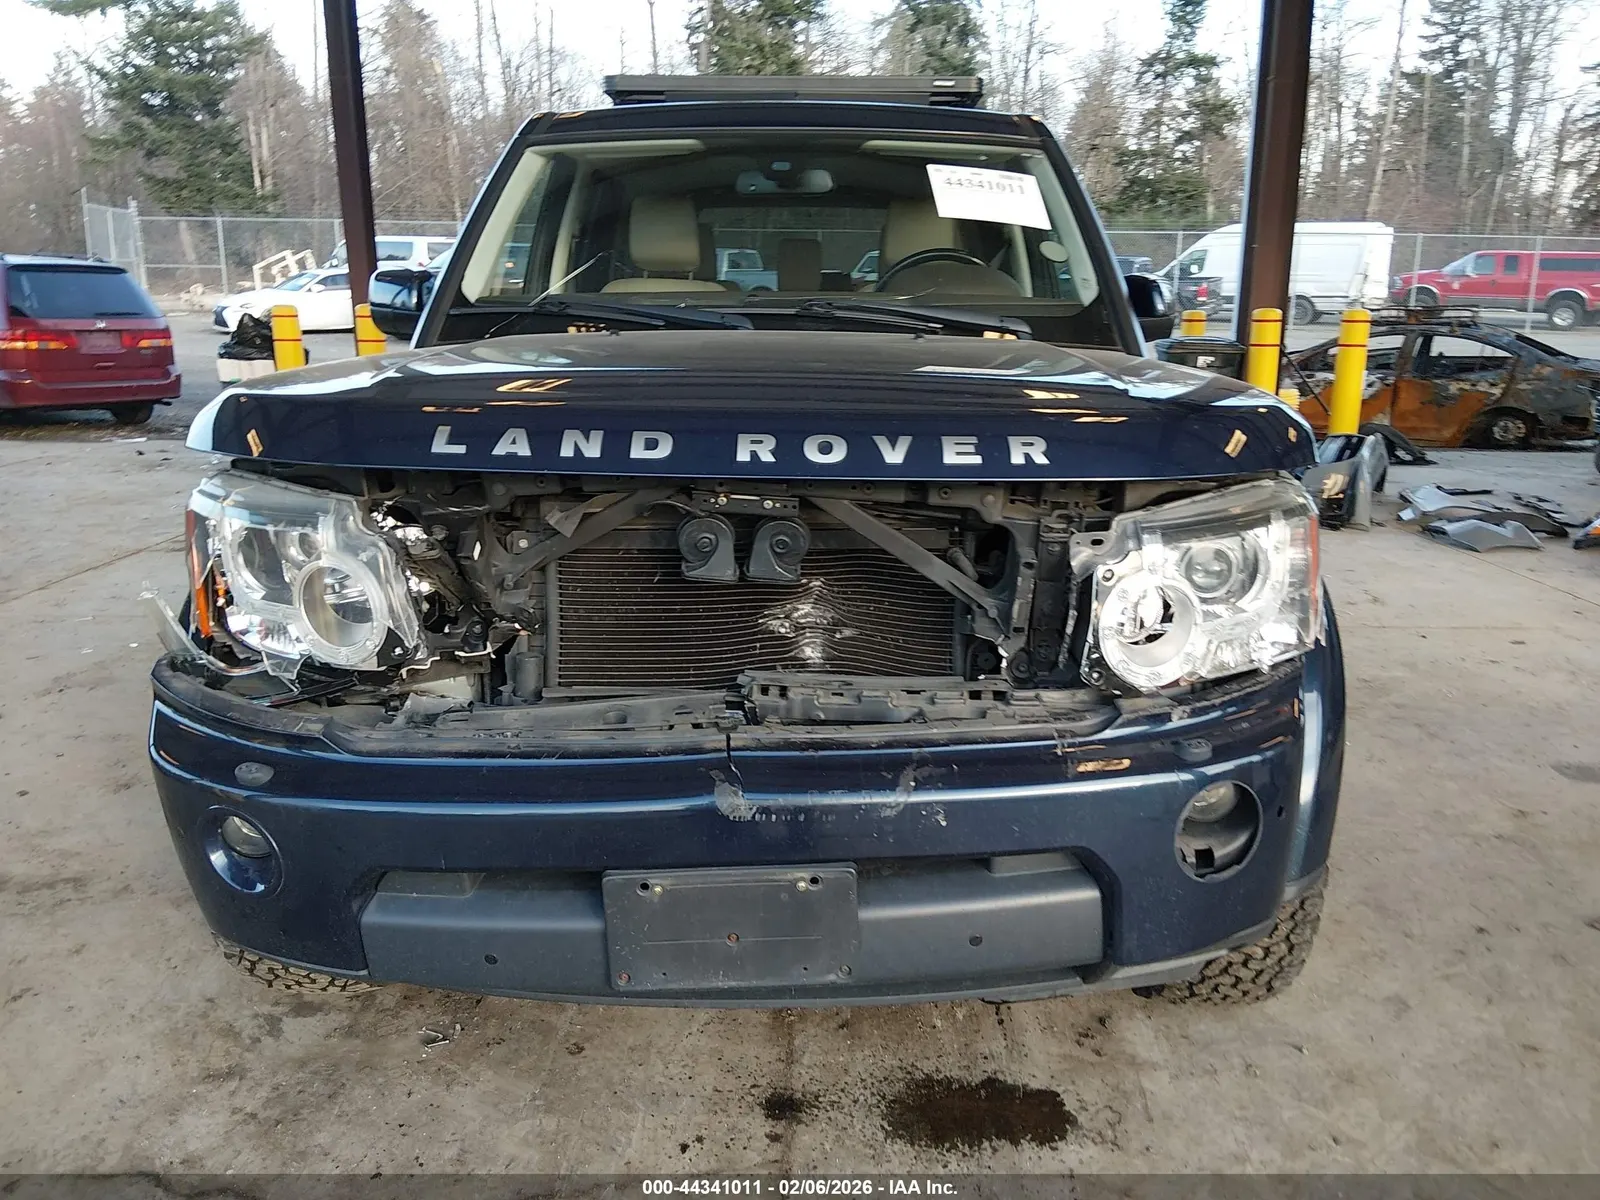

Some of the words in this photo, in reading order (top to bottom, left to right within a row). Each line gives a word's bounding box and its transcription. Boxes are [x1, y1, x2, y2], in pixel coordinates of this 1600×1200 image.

[943, 177, 1025, 195] 44341011
[430, 425, 674, 459] LAND
[736, 432, 1050, 466] ROVER
